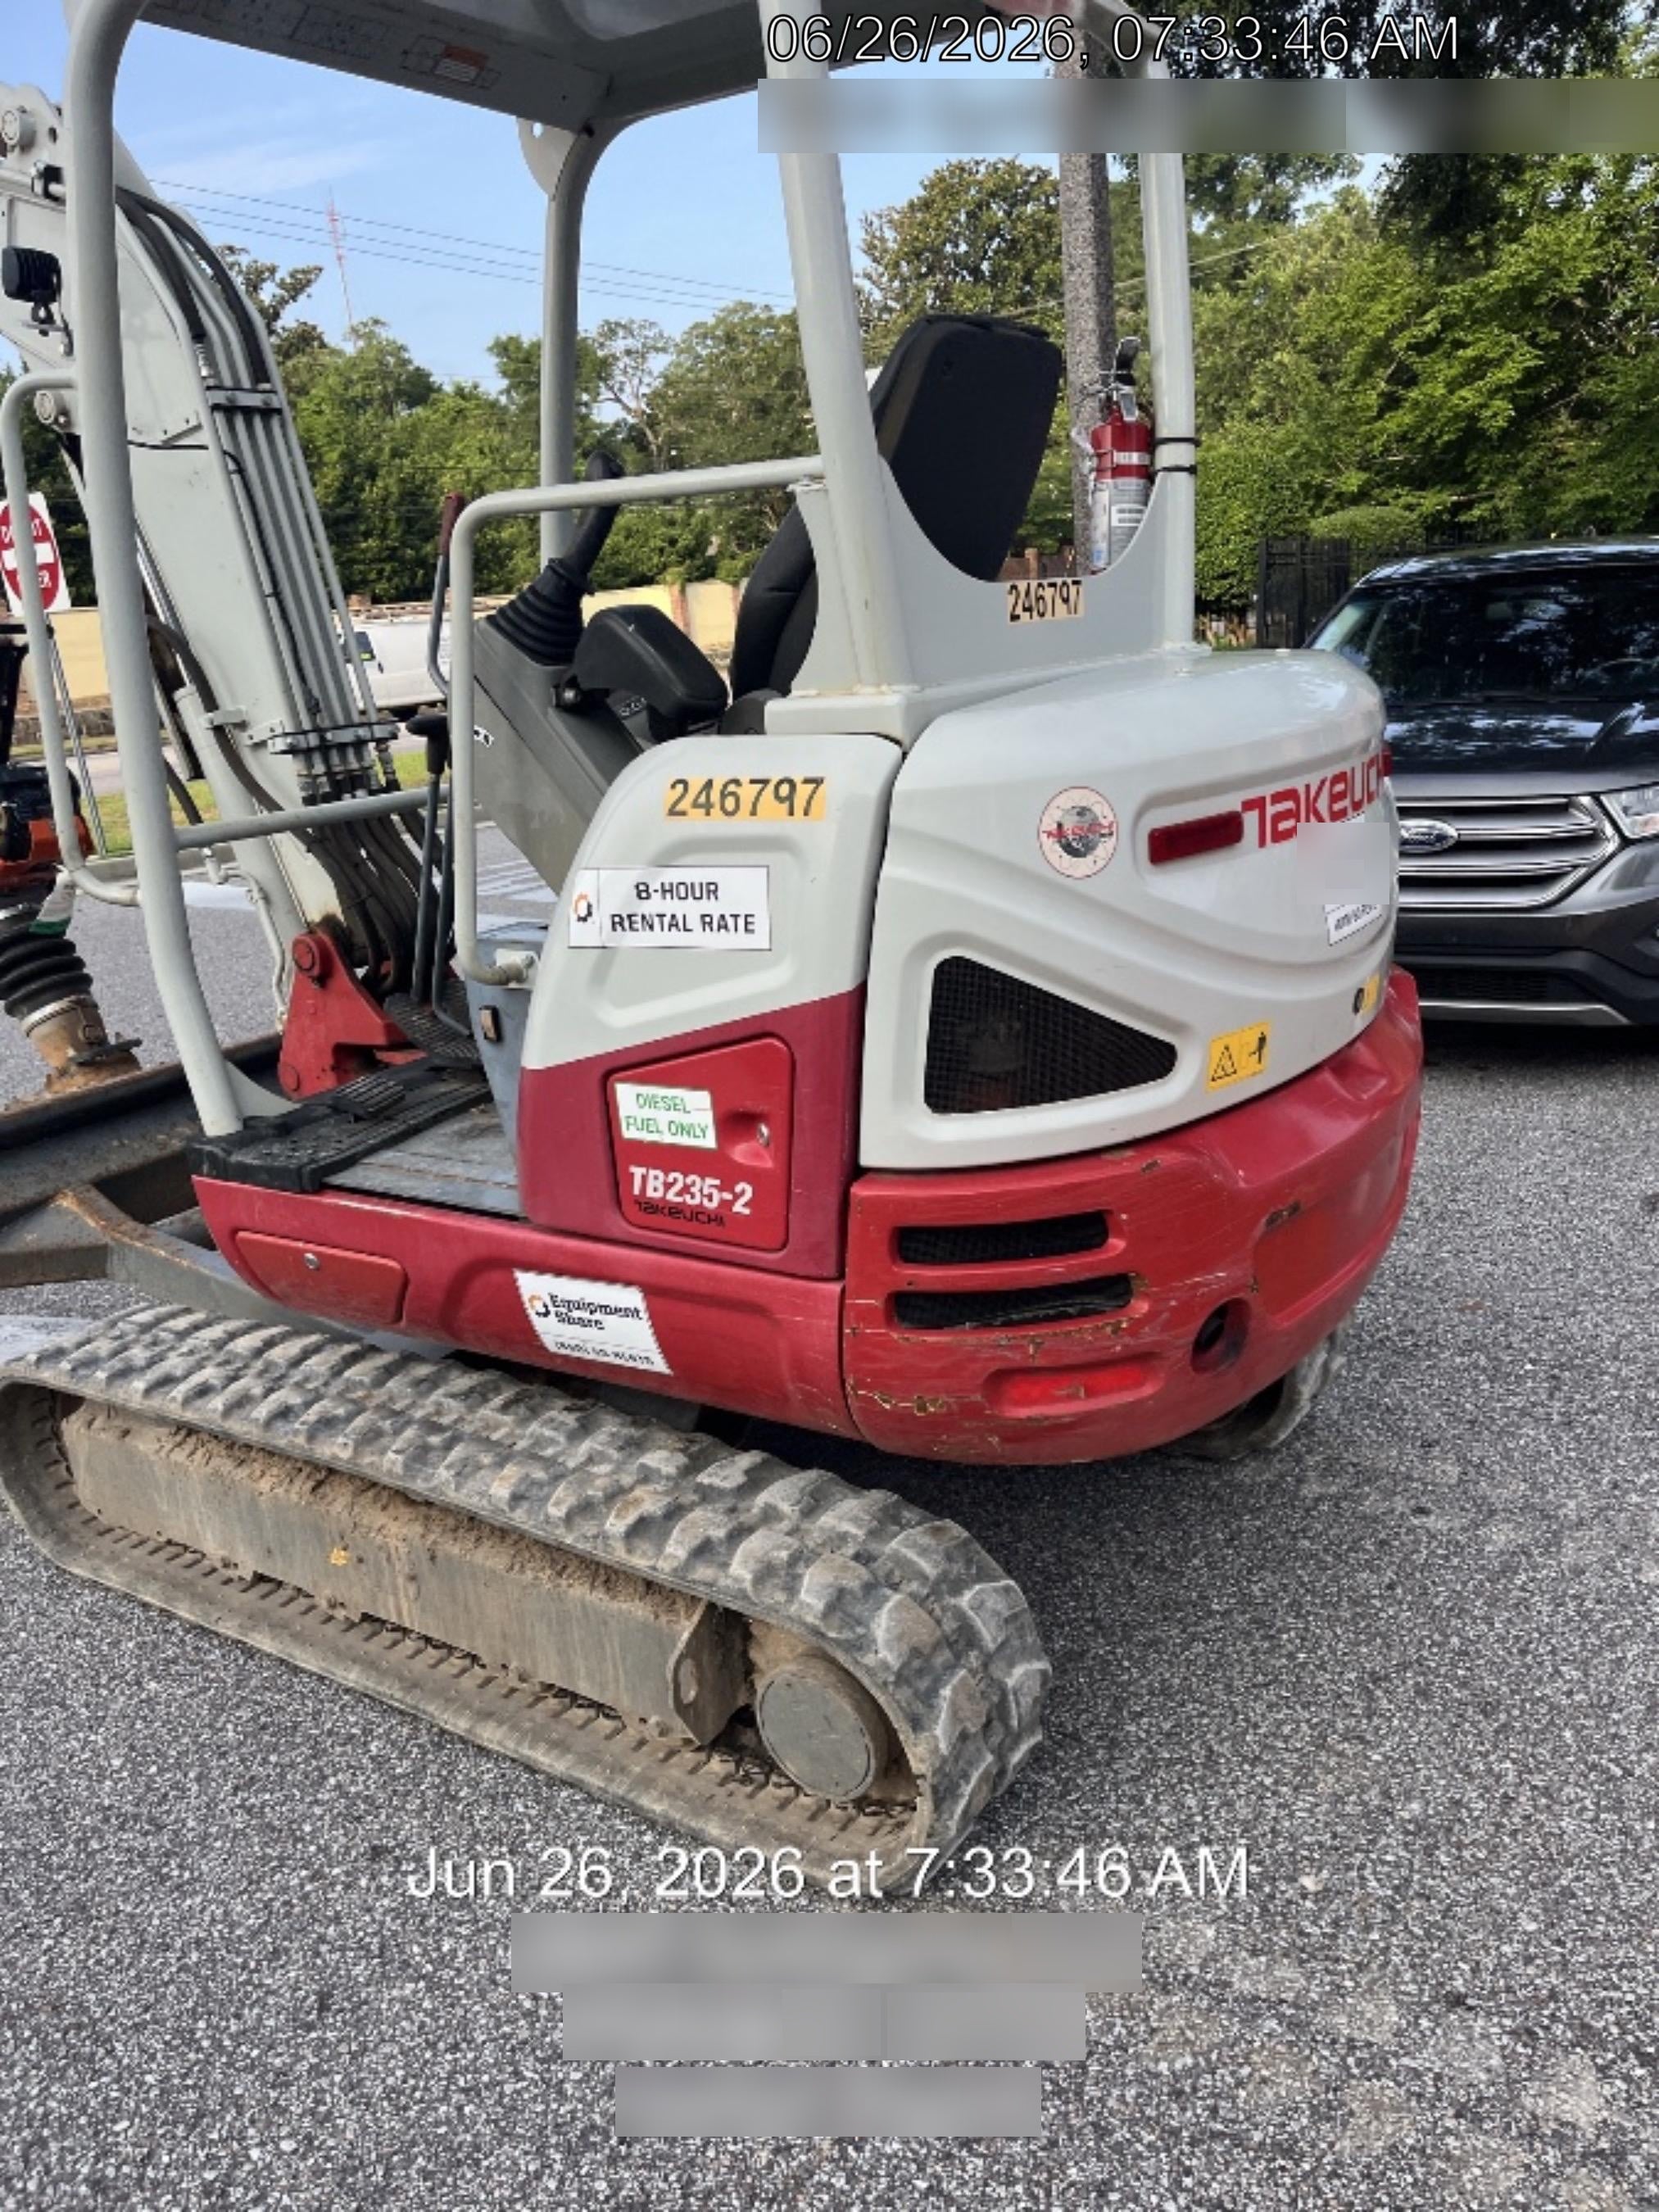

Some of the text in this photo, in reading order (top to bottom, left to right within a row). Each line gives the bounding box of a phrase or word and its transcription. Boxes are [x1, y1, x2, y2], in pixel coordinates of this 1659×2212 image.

[1007, 580, 1084, 623] 246797
[665, 776, 825, 818] 246797
[634, 881, 720, 901] 8-HOUR
[610, 912, 756, 935] RENTAL RATE
[635, 1092, 691, 1115] DIESEL
[624, 1115, 709, 1140] FUEL ONLY
[628, 1165, 753, 1216] TB235-2
